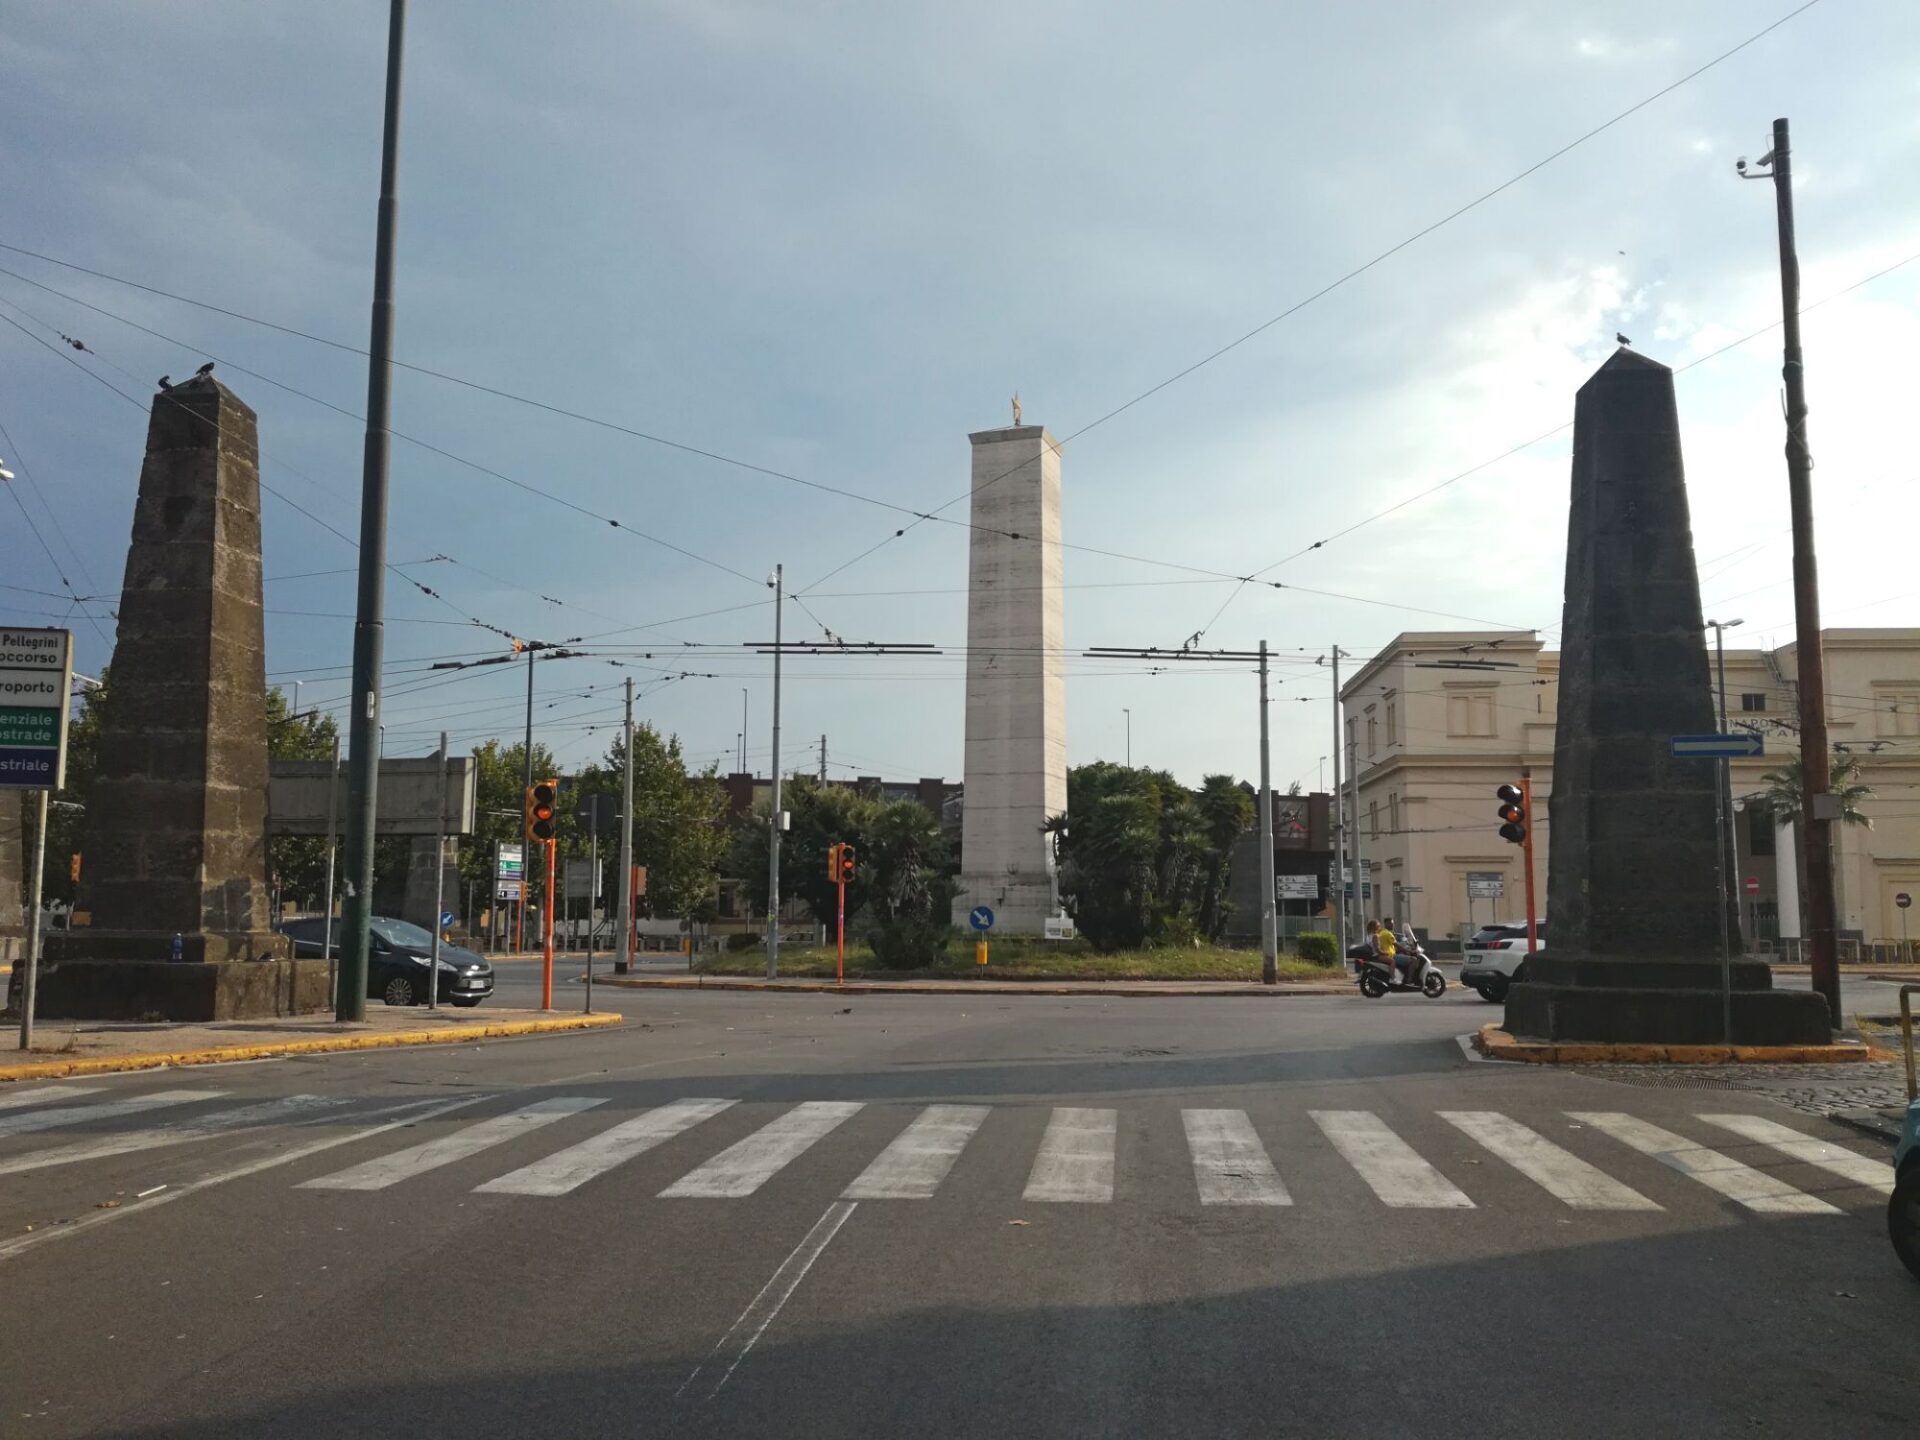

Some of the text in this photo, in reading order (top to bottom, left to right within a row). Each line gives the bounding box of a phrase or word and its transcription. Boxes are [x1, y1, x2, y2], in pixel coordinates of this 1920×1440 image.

[2, 634, 59, 650] Pellegrini
[0, 713, 53, 726] enziale
[0, 729, 52, 741] strade
[0, 759, 50, 772] striale
